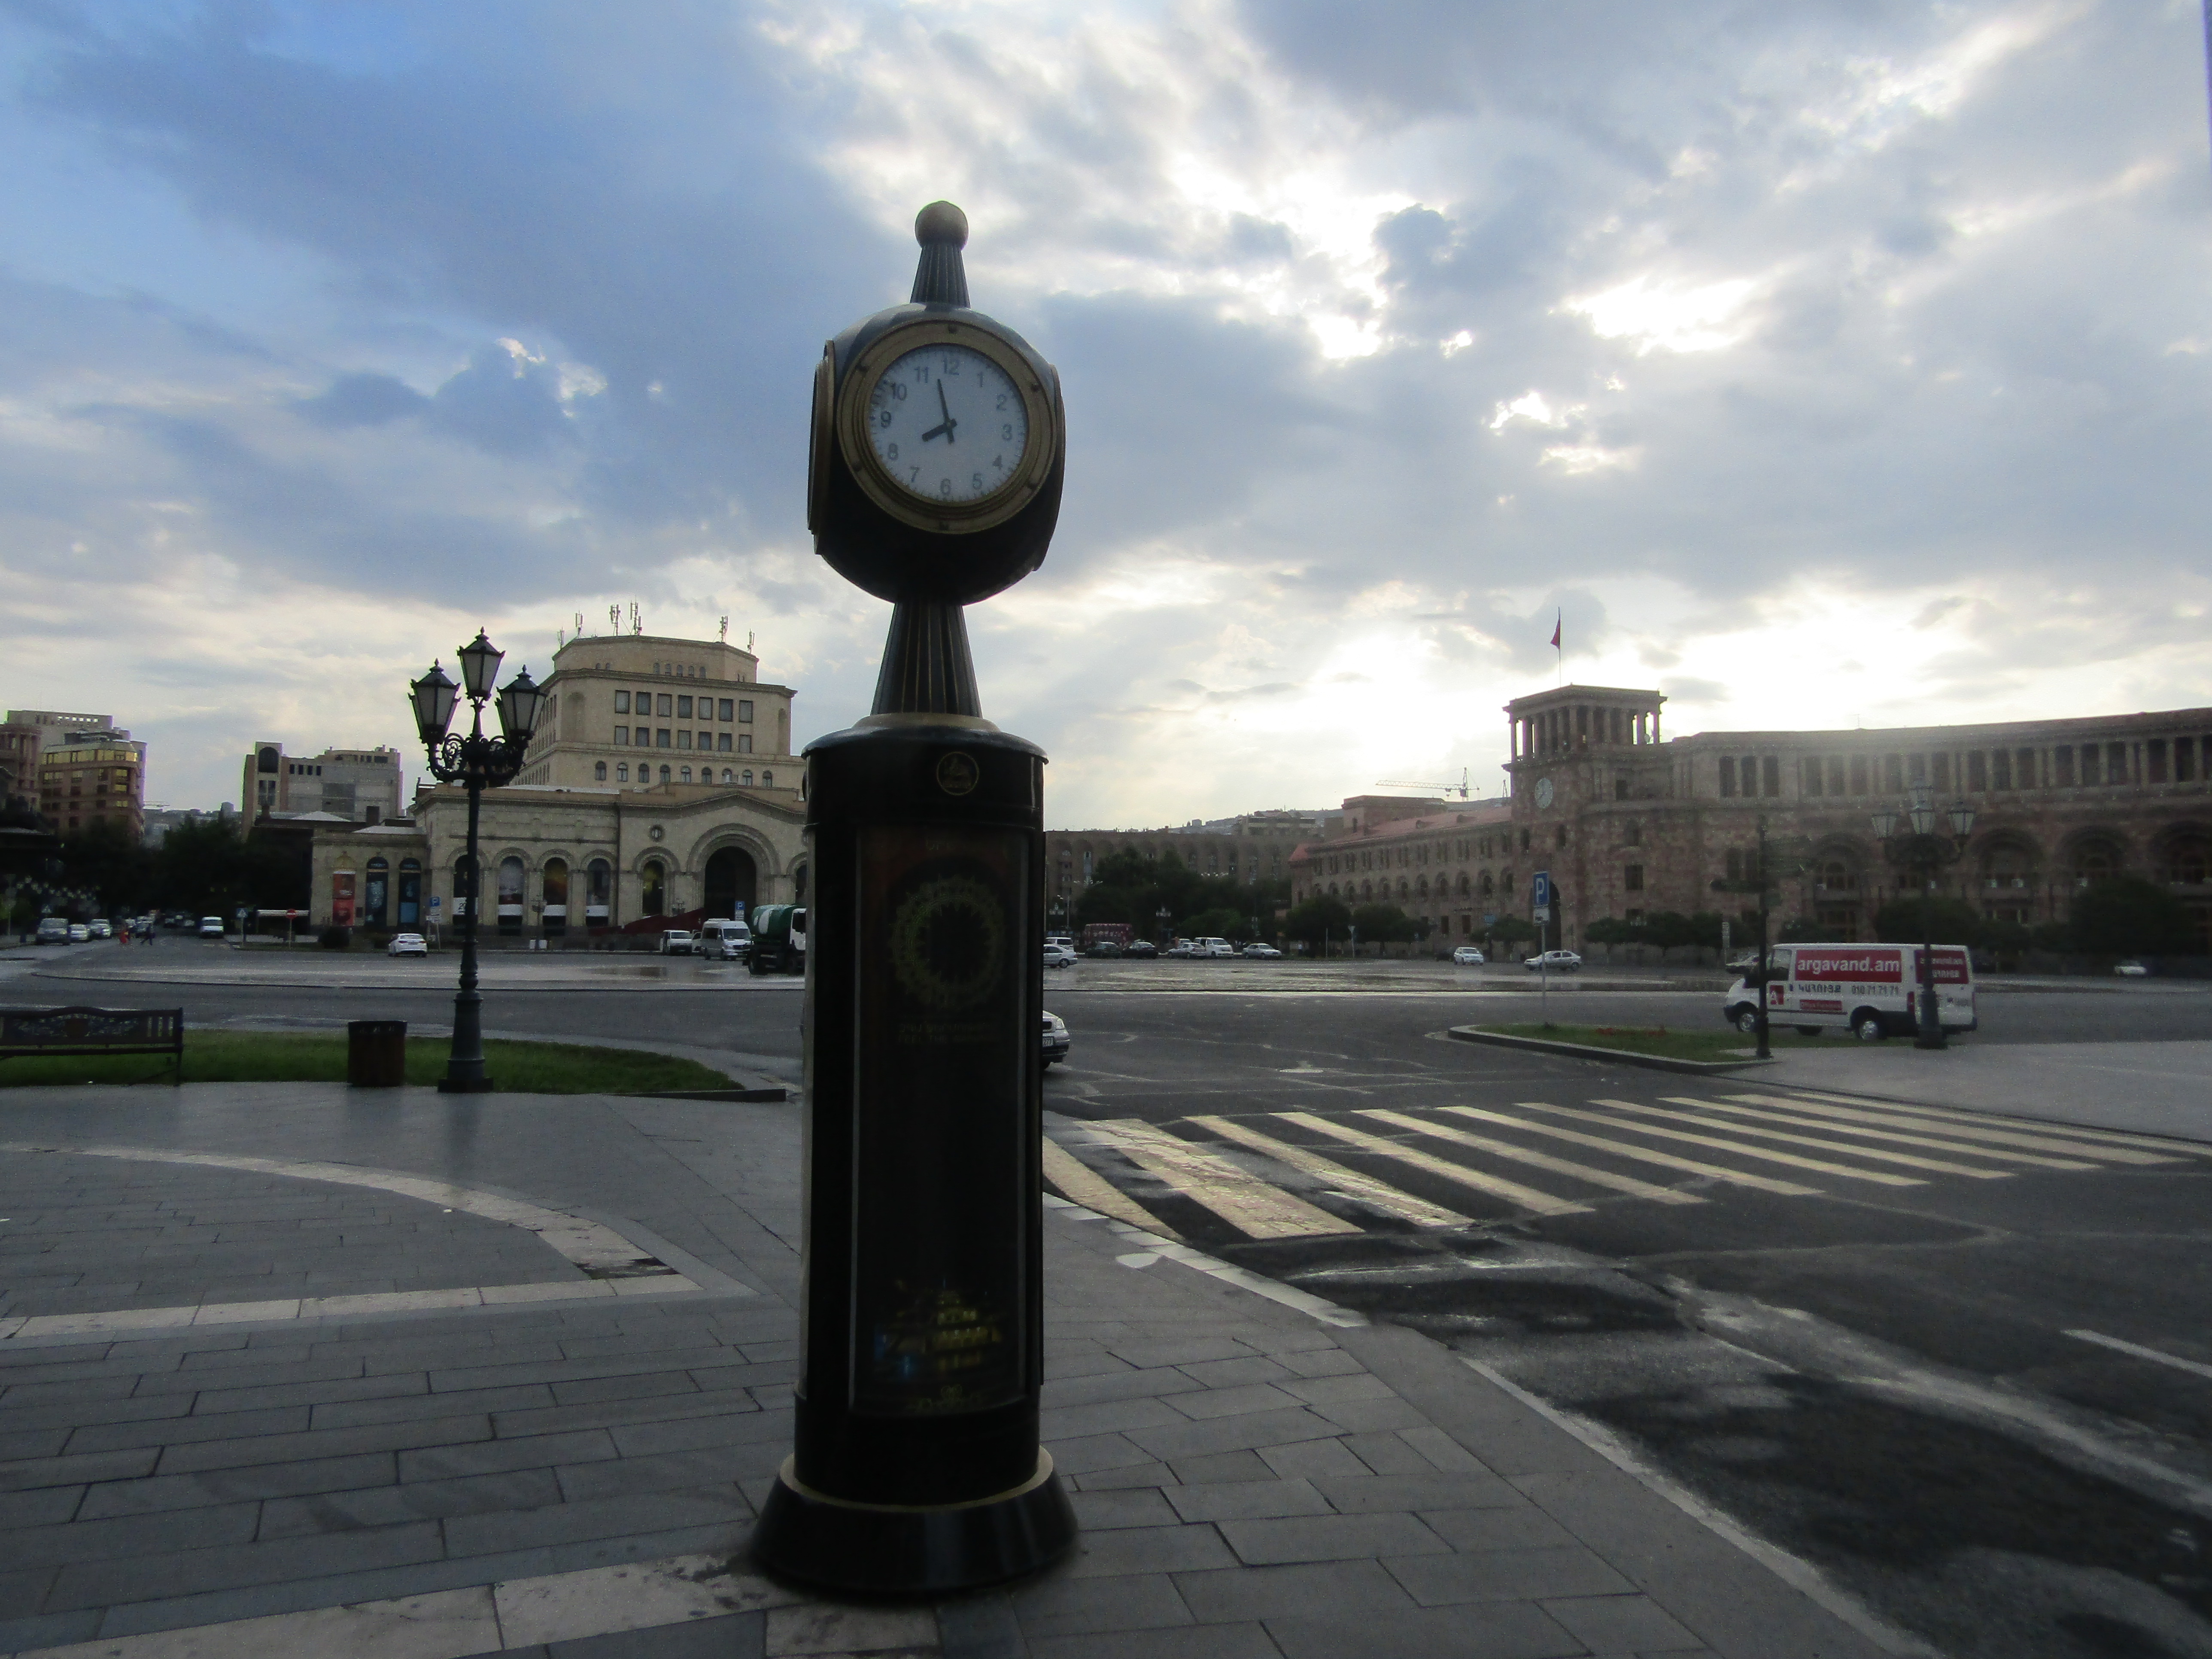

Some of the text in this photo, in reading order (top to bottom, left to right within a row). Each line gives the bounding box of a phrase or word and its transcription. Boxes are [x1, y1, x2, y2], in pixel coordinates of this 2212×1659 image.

[914, 366, 929, 383] 11
[944, 359, 960, 375] 12
[977, 371, 984, 387] 1
[890, 383, 907, 401] 10
[996, 394, 1007, 411] 2
[881, 411, 892, 428] 9
[1002, 424, 1012, 441] 3
[887, 443, 899, 460] 8
[992, 453, 1003, 470] 4
[910, 466, 920, 483] 7
[973, 473, 982, 490] 5
[940, 479, 951, 495] 6
[1536, 877, 1544, 904] P
[1798, 956, 1900, 975] argavand.am
